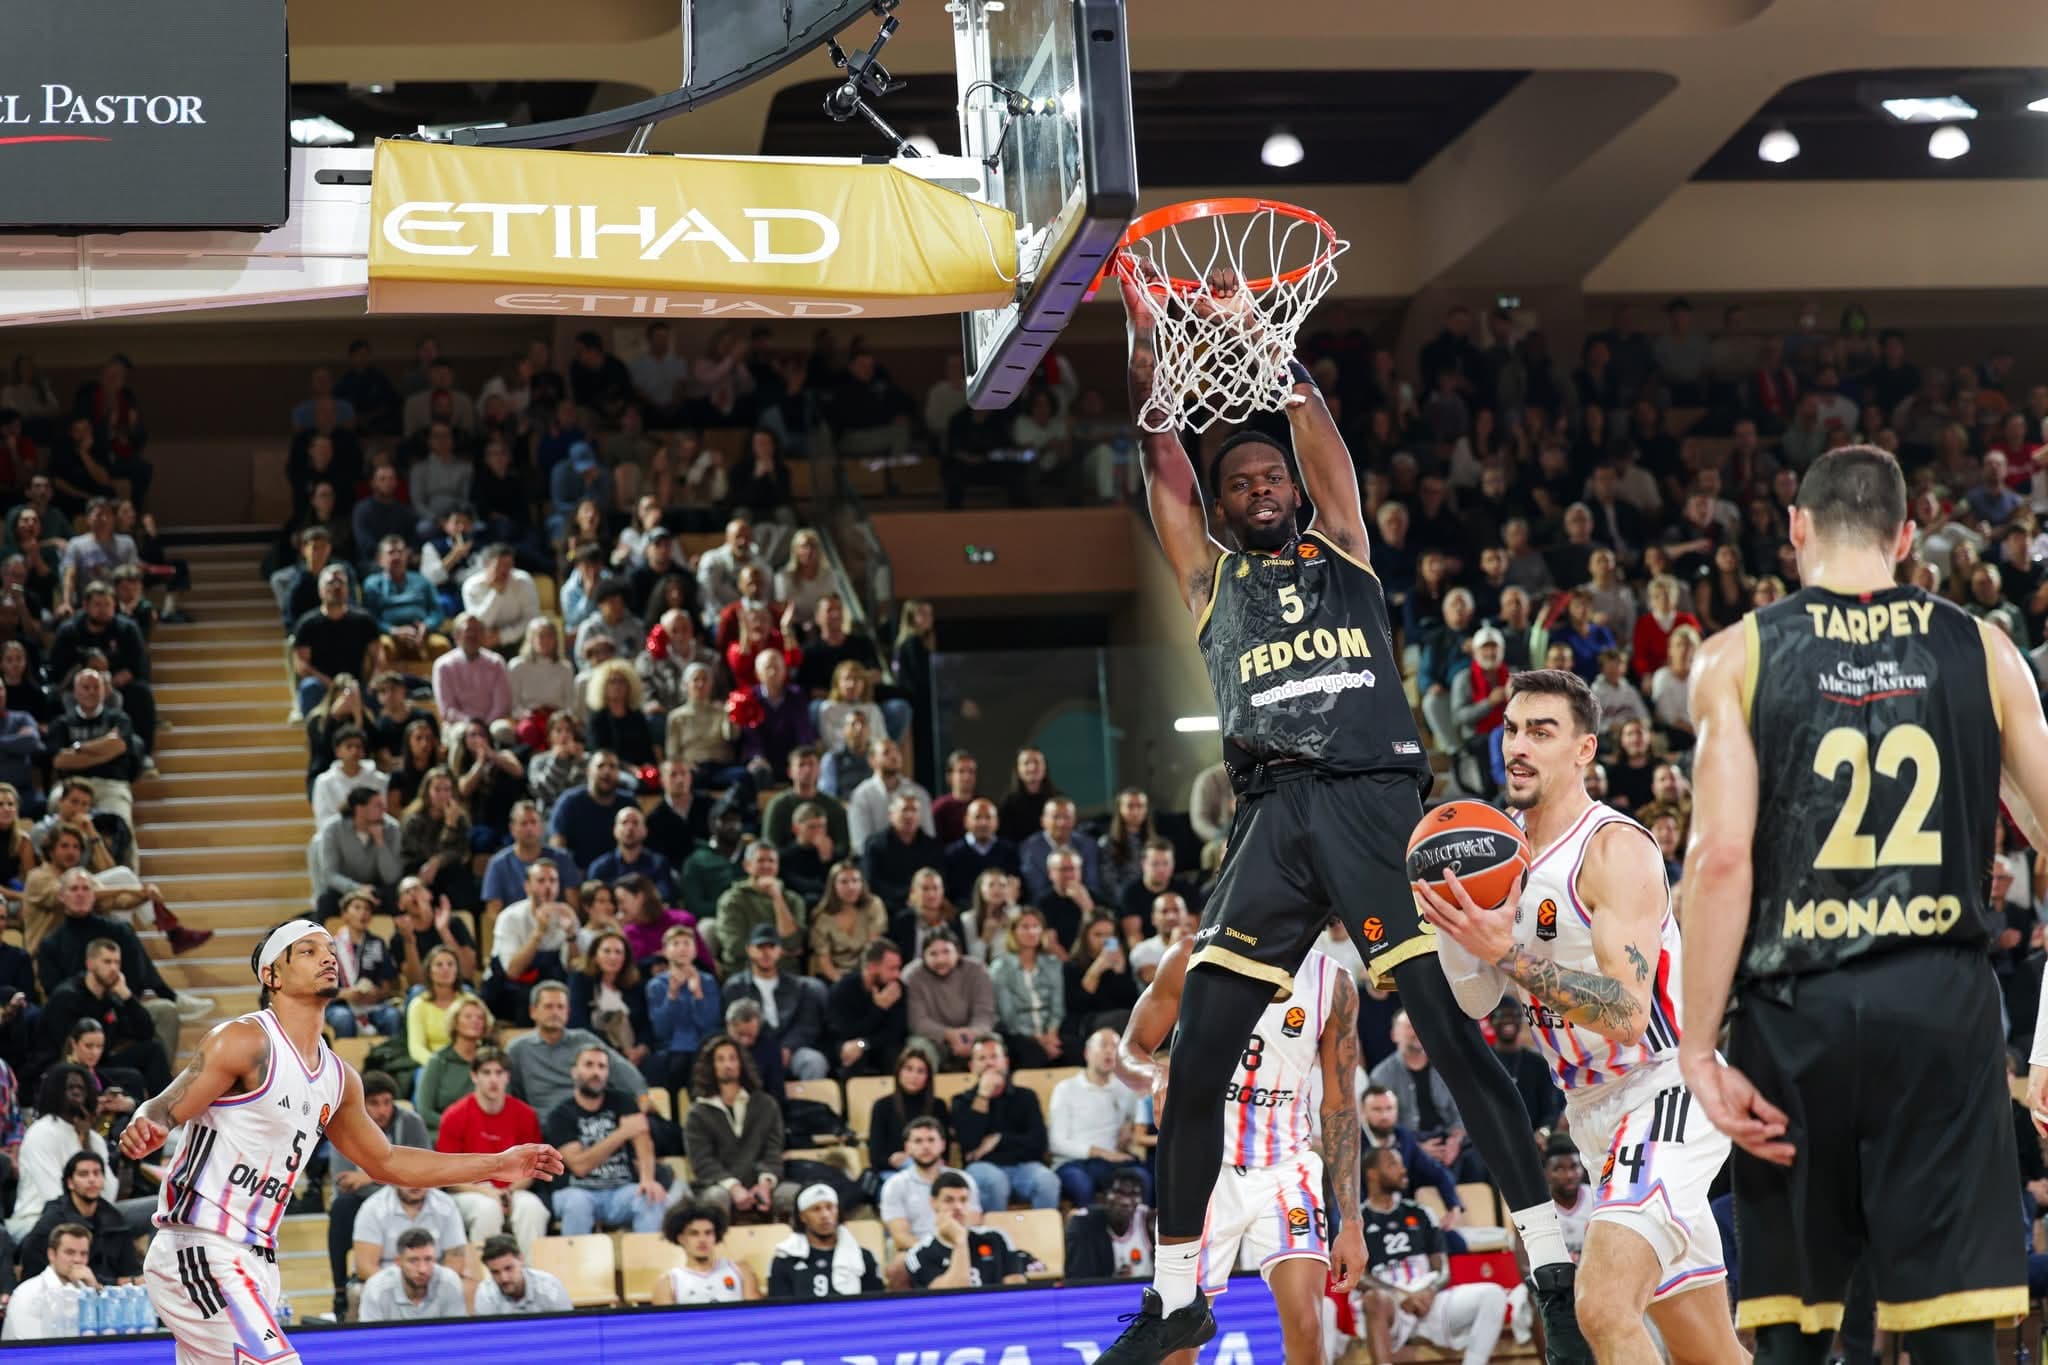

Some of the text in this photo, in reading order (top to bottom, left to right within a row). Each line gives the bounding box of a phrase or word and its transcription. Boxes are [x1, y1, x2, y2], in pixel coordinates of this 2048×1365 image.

[40, 84, 206, 124] PASTOR
[383, 201, 840, 264] ETIHAD
[494, 293, 864, 319] ETIHAD
[1278, 584, 1304, 624] 5
[1806, 600, 1935, 645] TARPEY
[1239, 628, 1372, 684] FEDCOM
[1813, 724, 1943, 870] 22
[1783, 895, 1962, 939] MONACO
[286, 1129, 307, 1172] 5
[1618, 1143, 1646, 1185] 4
[1383, 1232, 1412, 1255] 22
[812, 1275, 829, 1297] 9
